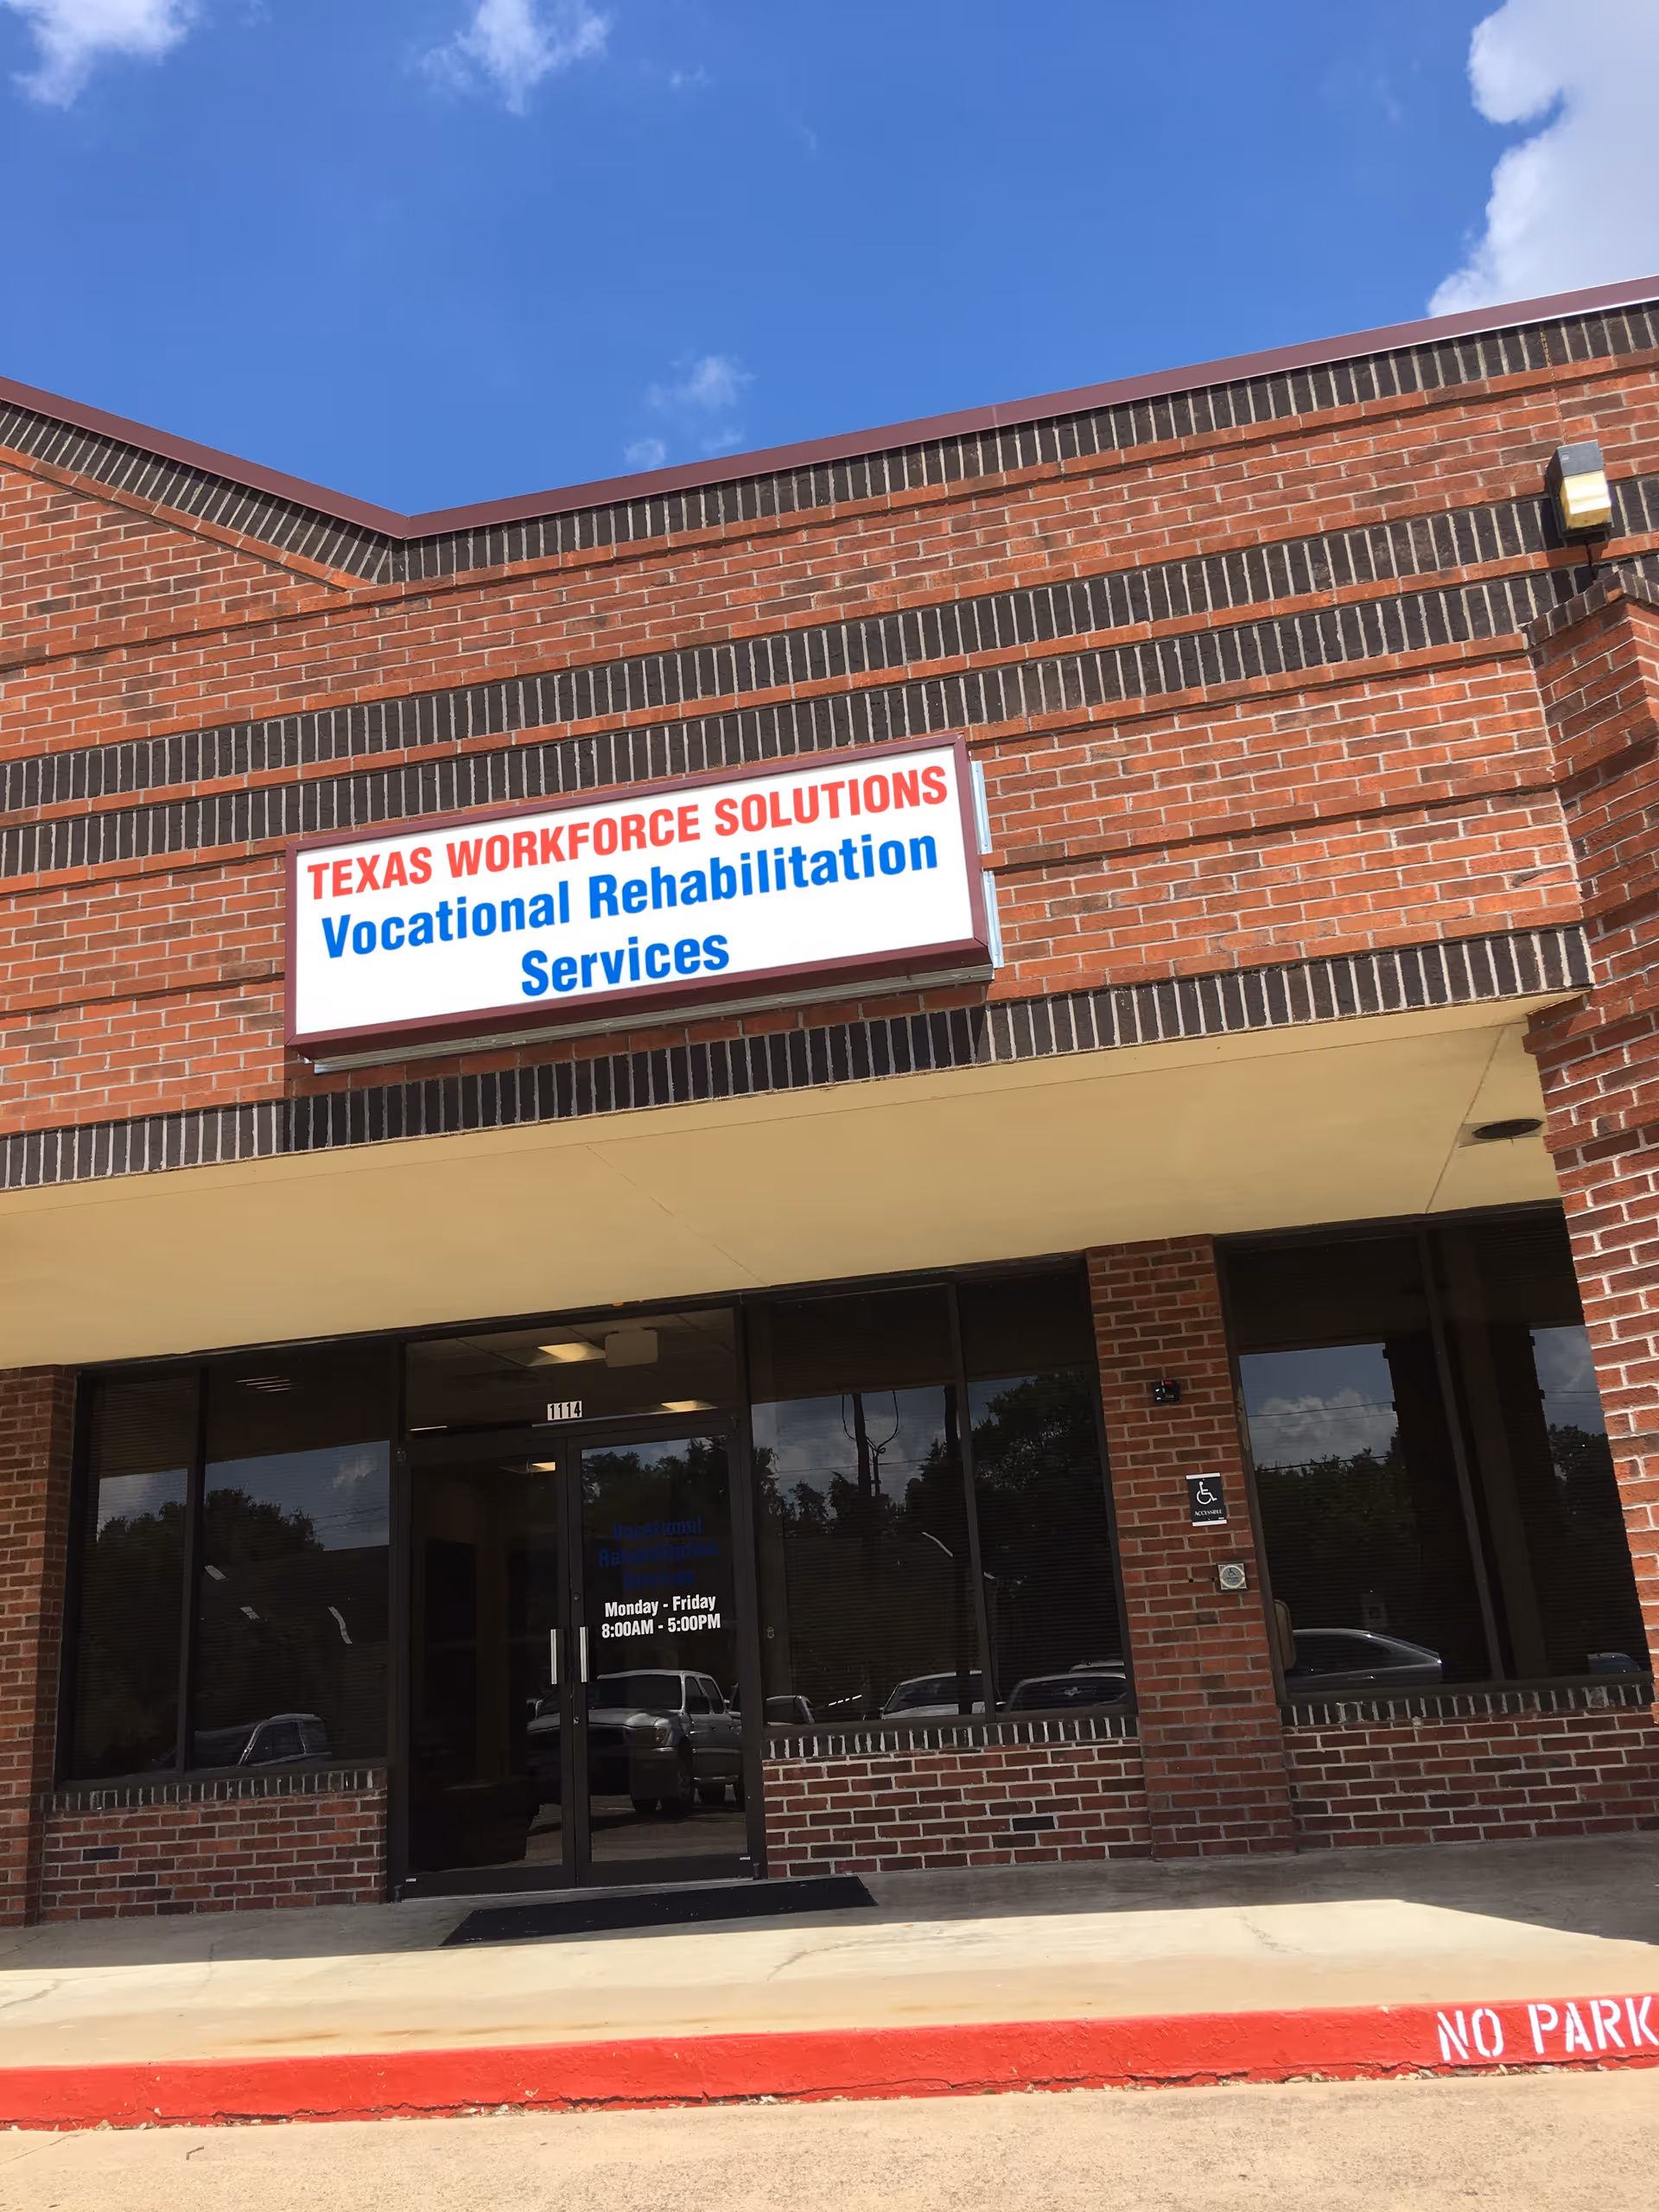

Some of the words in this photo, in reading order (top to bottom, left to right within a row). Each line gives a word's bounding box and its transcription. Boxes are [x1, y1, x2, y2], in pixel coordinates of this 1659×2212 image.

[307, 846, 432, 900] TEXAS
[446, 804, 701, 879] WORKFORCE
[715, 766, 948, 836] SOLUTIONS
[321, 880, 570, 959] Vocational
[588, 833, 938, 919] Rehabilitation
[521, 934, 730, 997] Services
[550, 1402, 582, 1420] 1114
[612, 1515, 702, 1540] Vocational
[601, 1618, 654, 1638] 8:00AM
[667, 1613, 721, 1633] 5:00PM
[604, 1599, 658, 1618] Monday
[672, 1594, 716, 1611] Friday
[1436, 2008, 1504, 2061] NO
[1527, 1996, 1659, 2055] PARK
